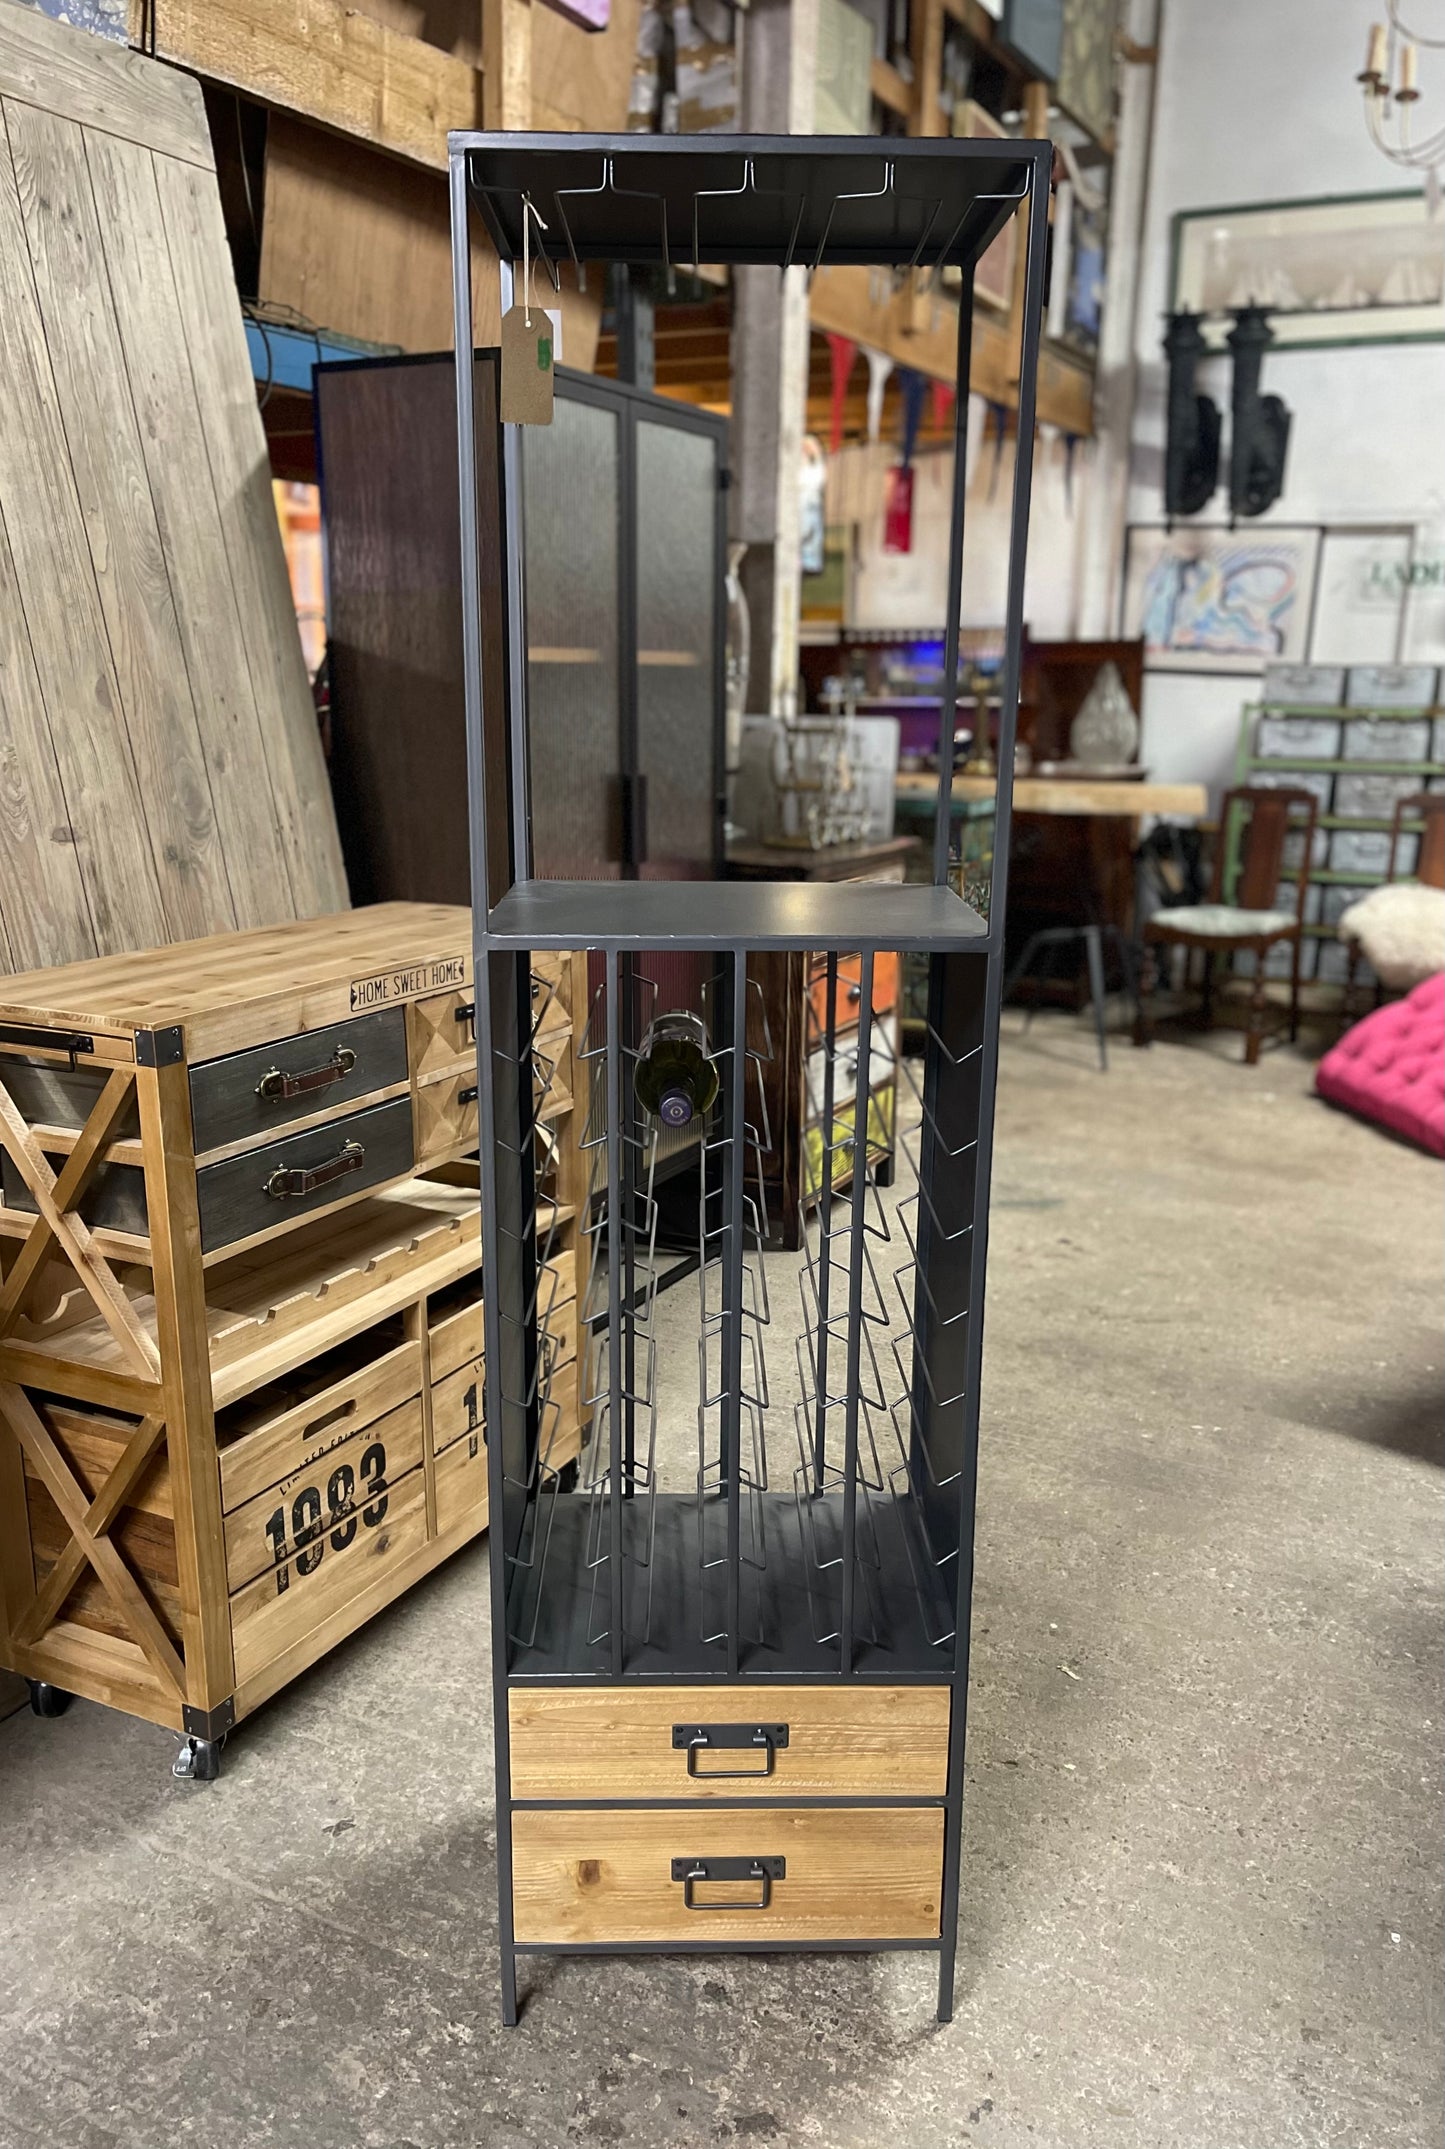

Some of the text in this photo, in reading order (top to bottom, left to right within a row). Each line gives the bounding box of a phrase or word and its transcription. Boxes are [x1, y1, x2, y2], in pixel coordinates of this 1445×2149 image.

[358, 961, 458, 1005] HOME SWEET HOME
[265, 1442, 388, 1596] 1983
